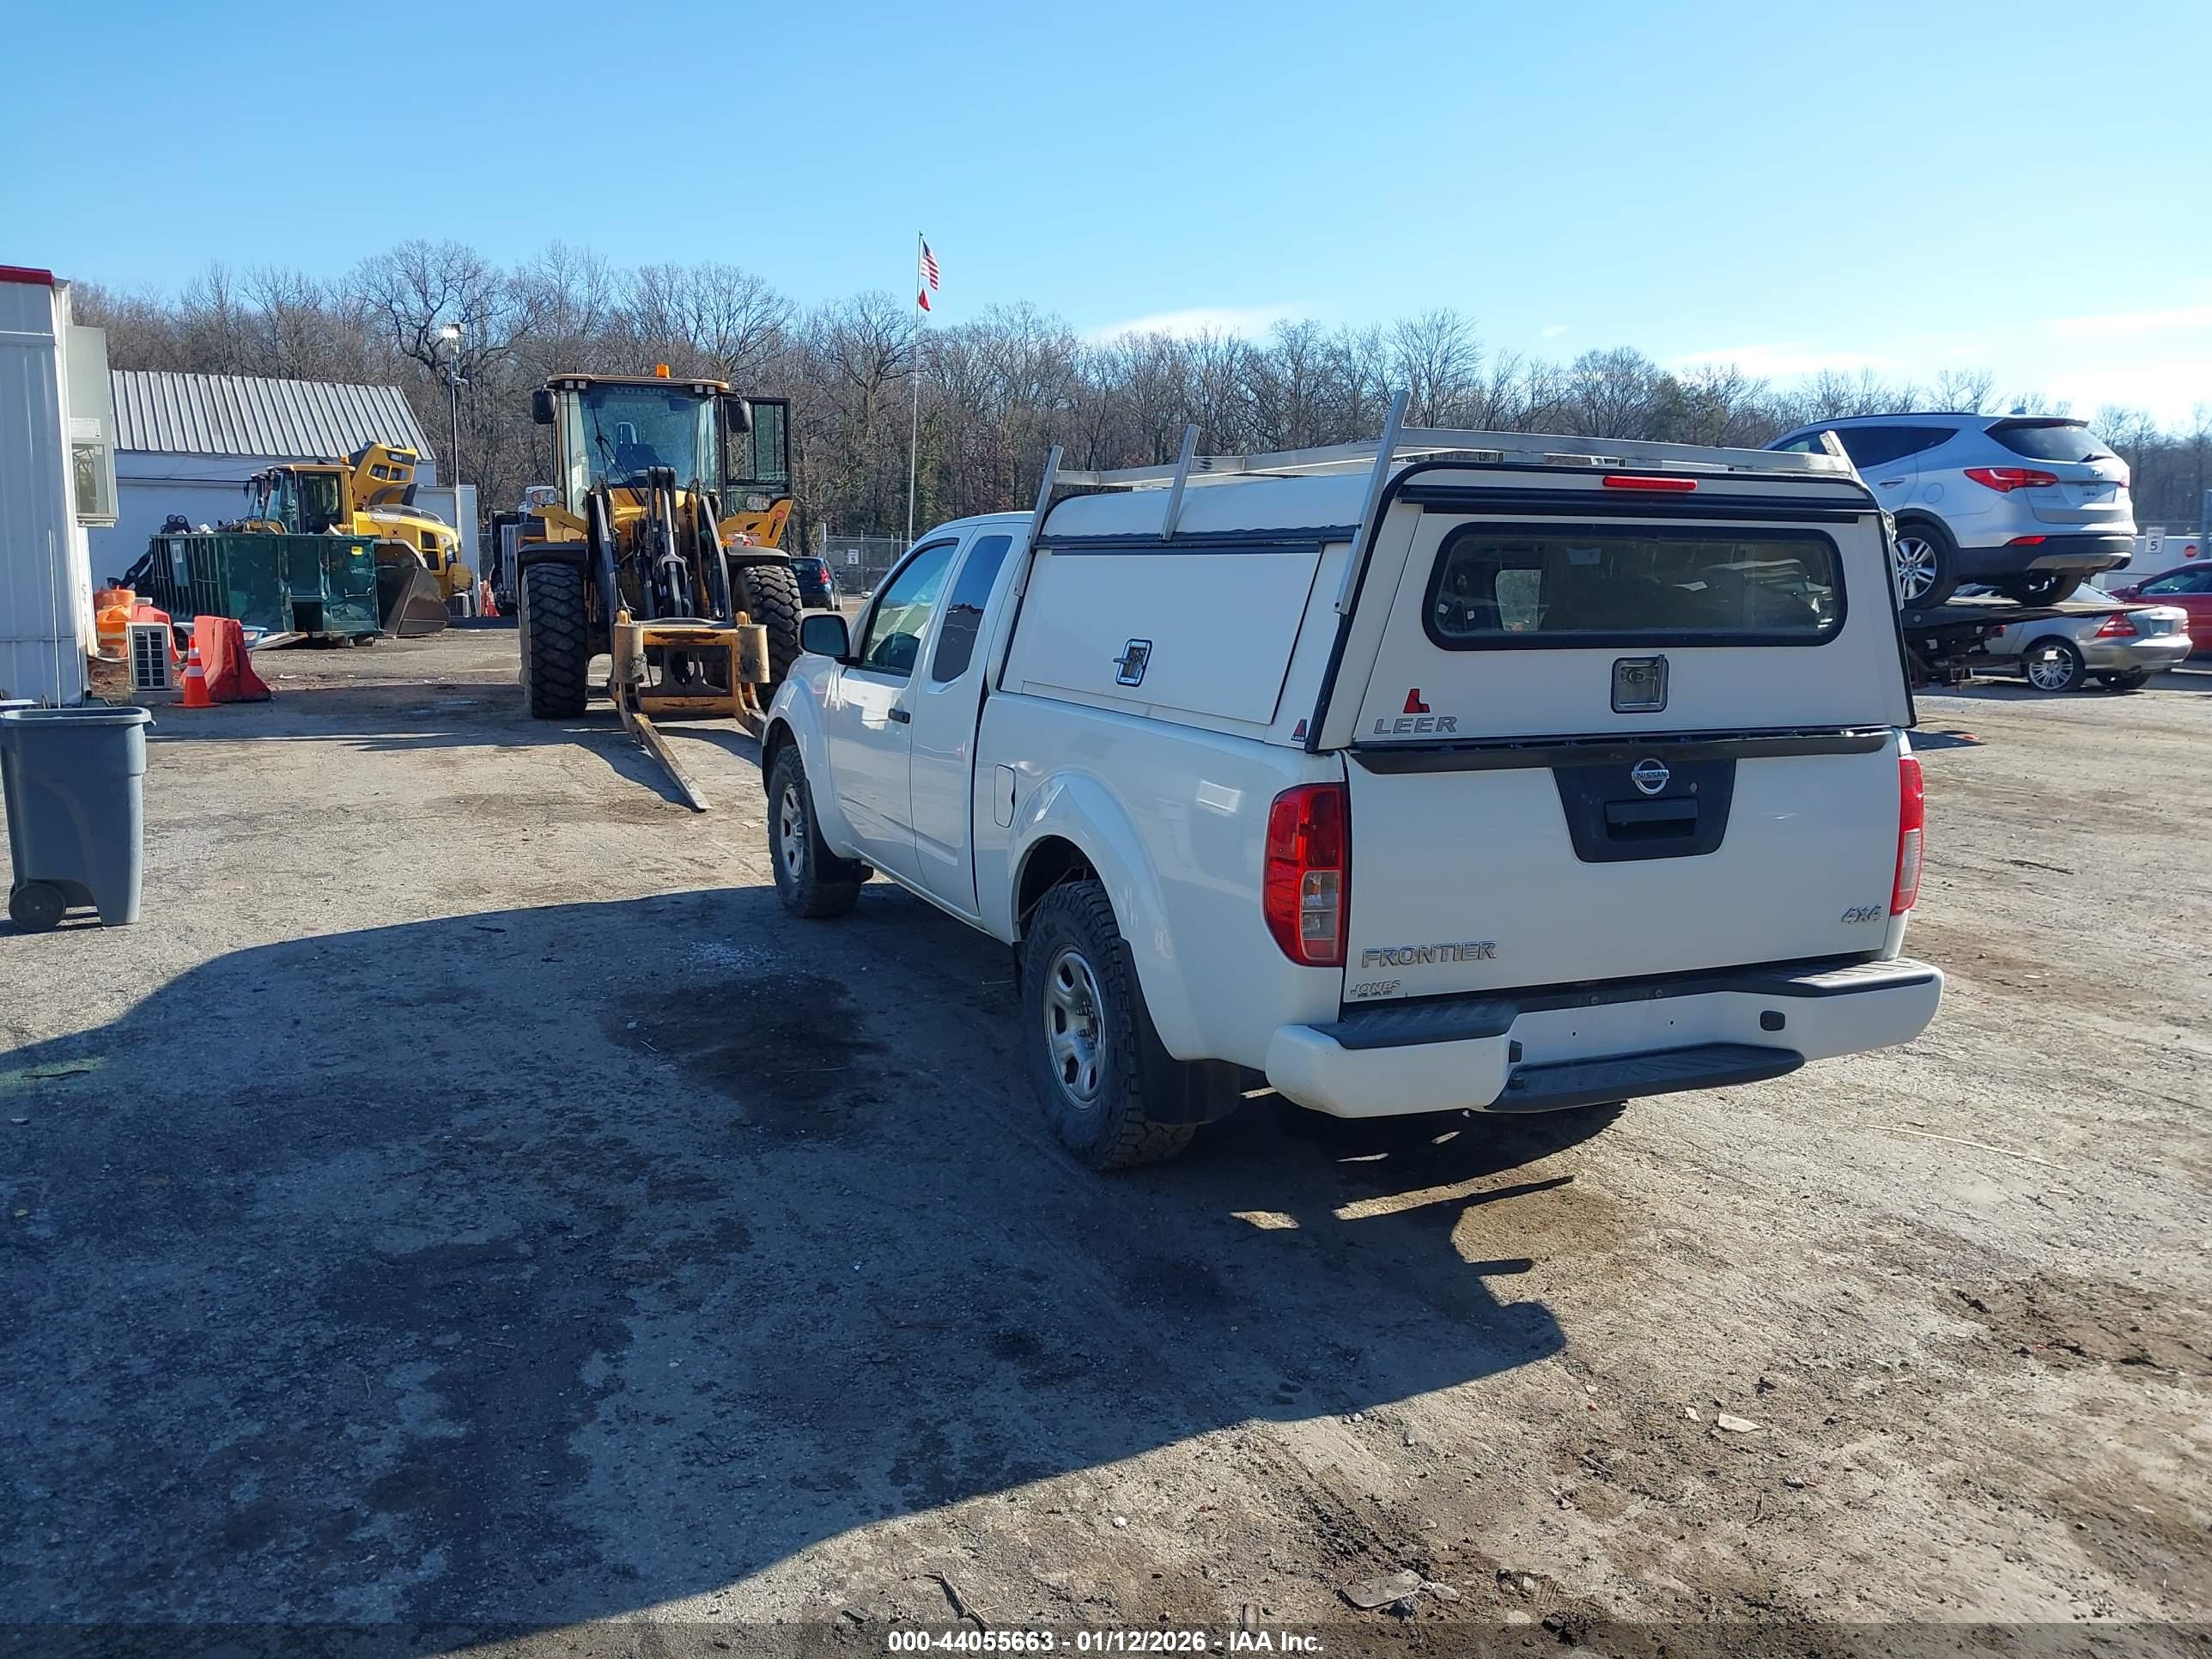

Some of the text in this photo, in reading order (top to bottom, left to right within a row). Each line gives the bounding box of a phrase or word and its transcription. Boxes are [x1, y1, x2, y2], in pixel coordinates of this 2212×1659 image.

[612, 386, 668, 396] VOLVO
[2149, 540, 2158, 550] 5
[1373, 716, 1457, 734] LEER
[1361, 940, 1497, 969] FRONTIER
[1350, 979, 1401, 994] JONES
